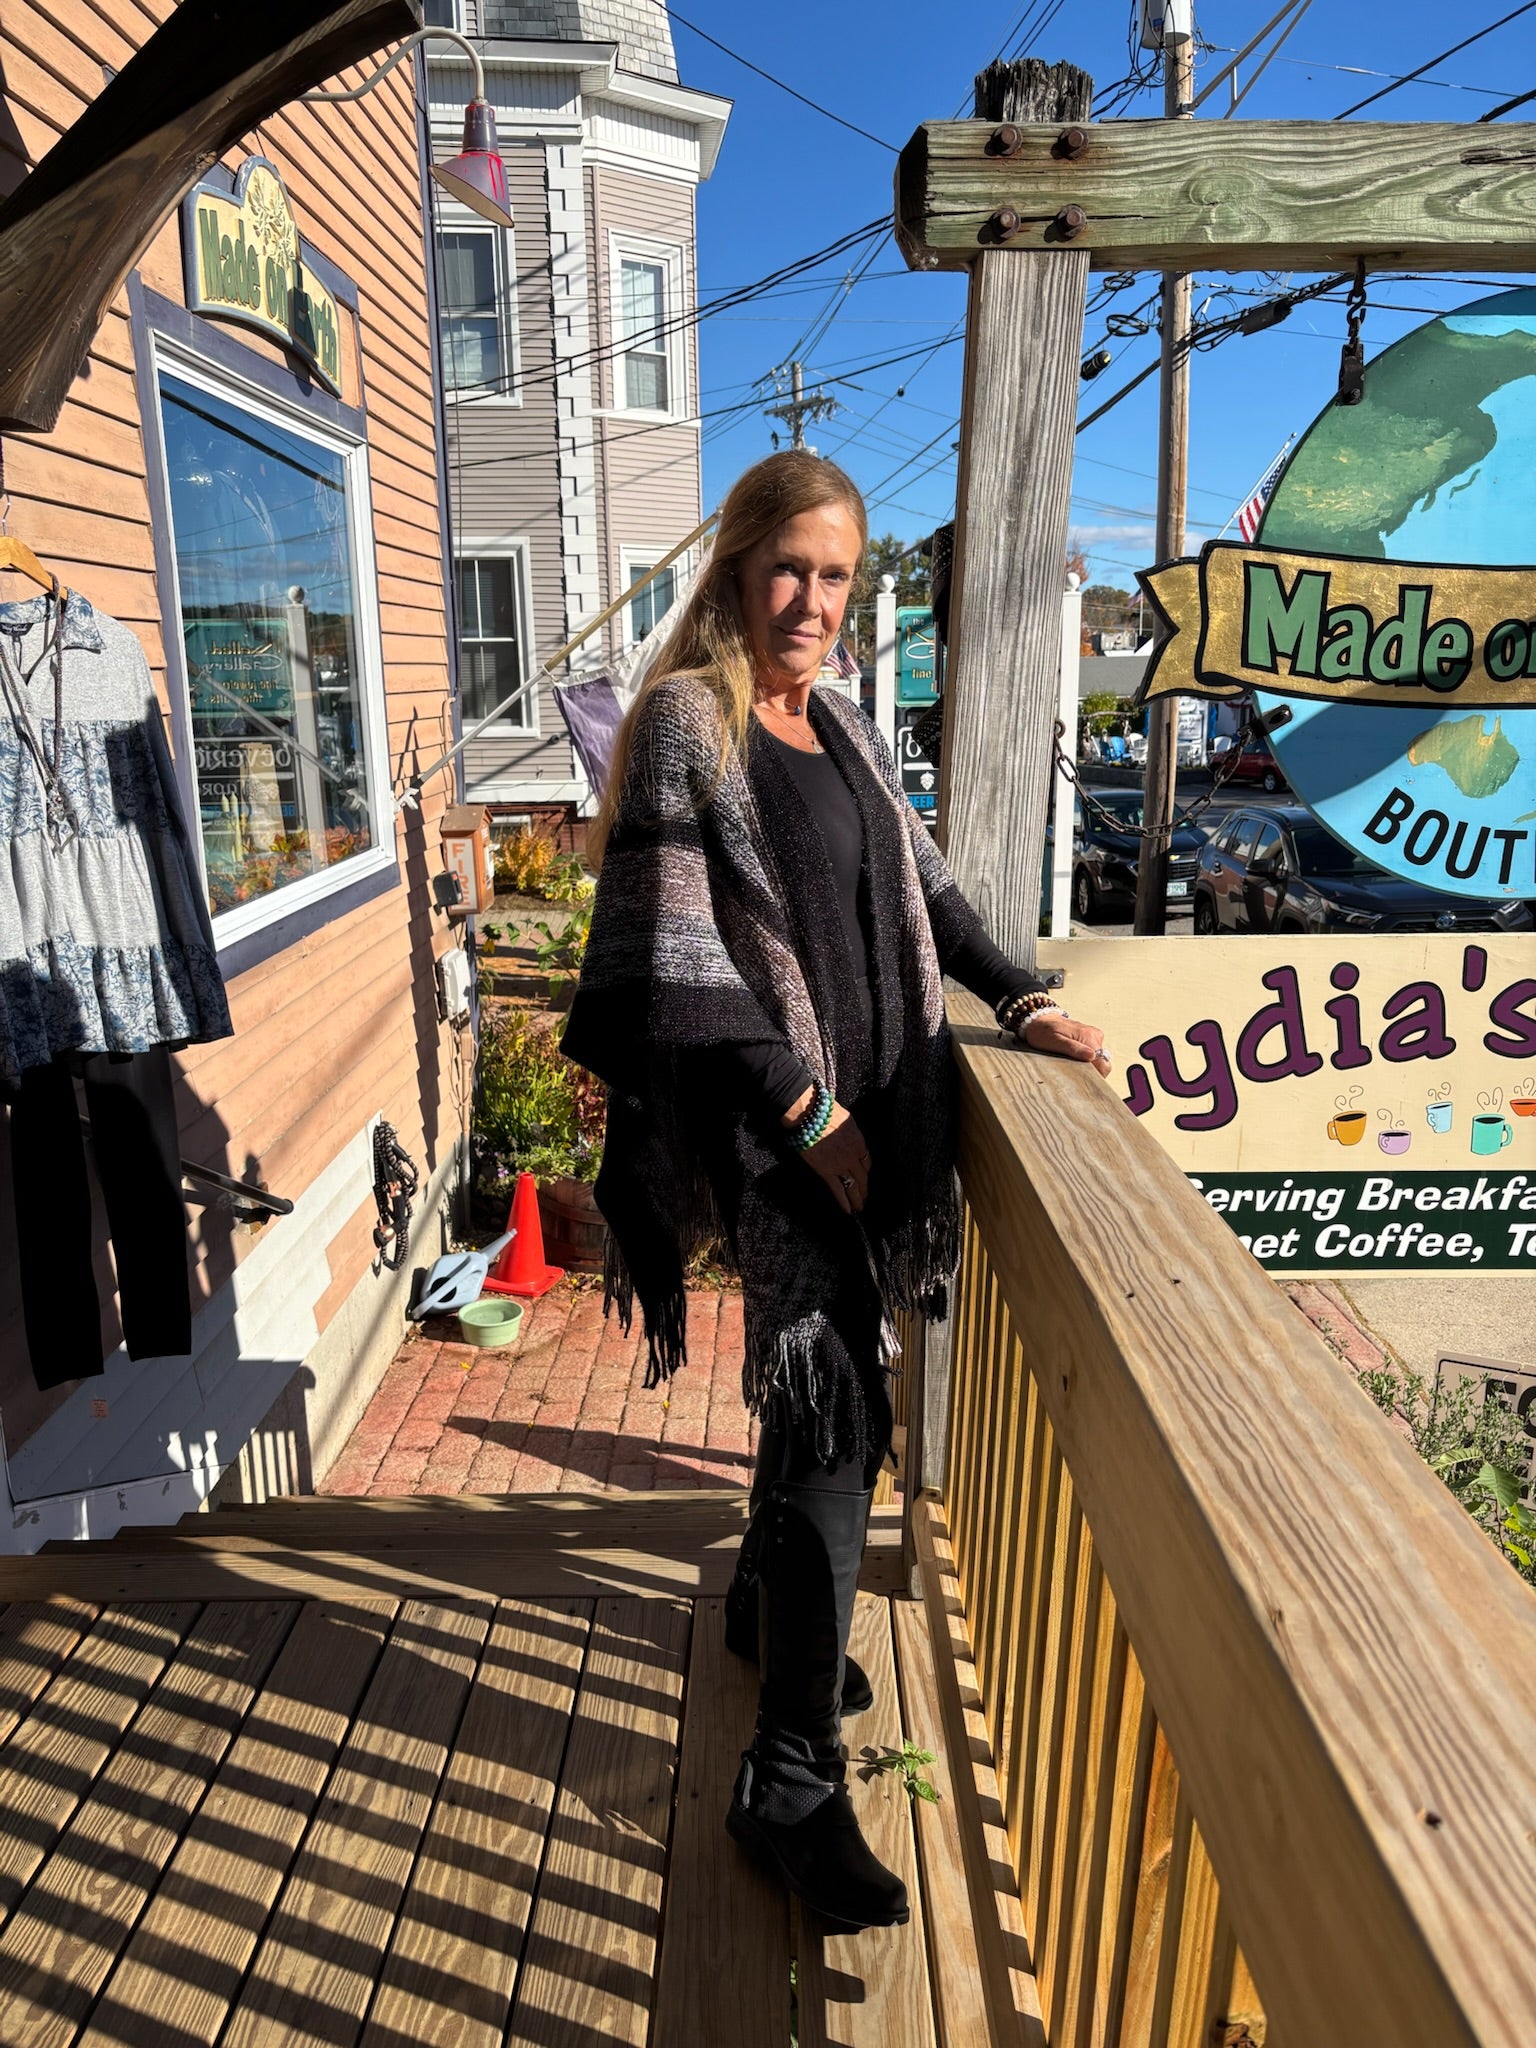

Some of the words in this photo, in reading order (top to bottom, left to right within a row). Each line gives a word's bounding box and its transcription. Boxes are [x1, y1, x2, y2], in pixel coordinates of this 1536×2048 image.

[199, 208, 260, 310] Made
[265, 256, 289, 327] on
[1241, 560, 1474, 692] Made
[1484, 618, 1536, 682] o
[1362, 787, 1536, 884] BOUT
[1188, 1178, 1339, 1221] erving
[1314, 1222, 1485, 1263] Coffee,
